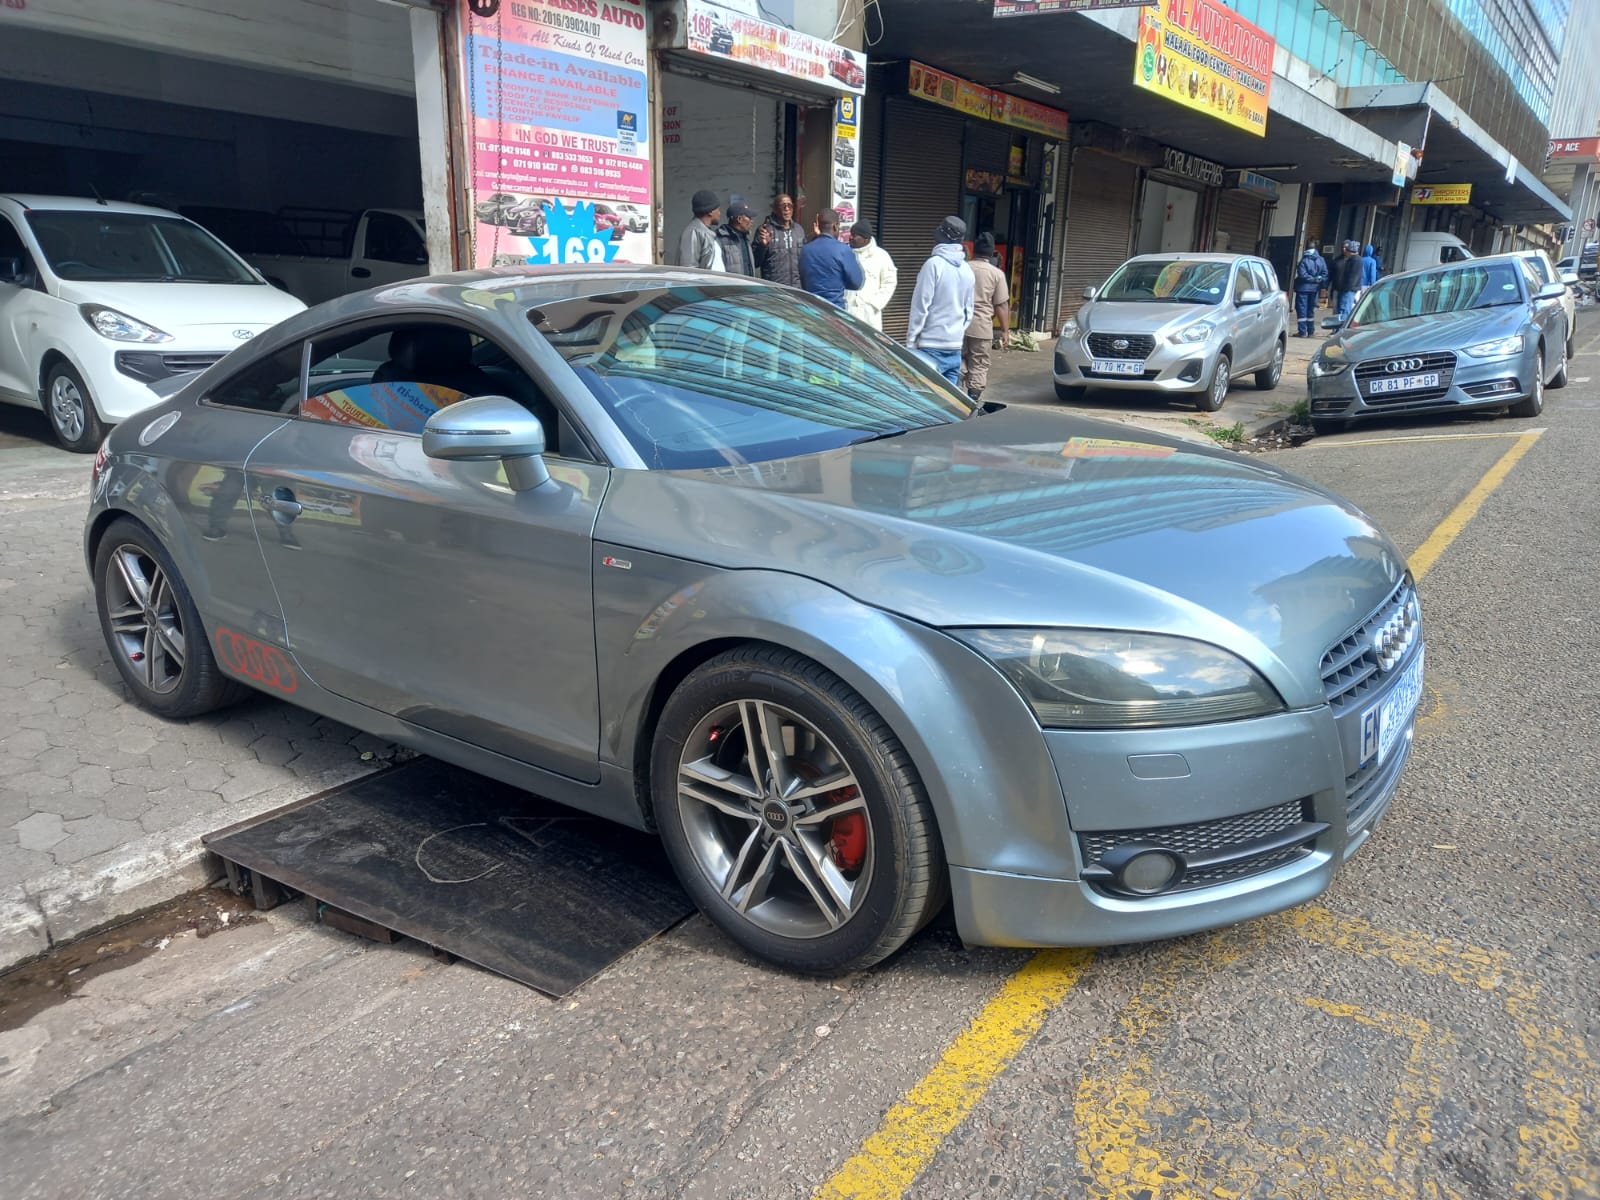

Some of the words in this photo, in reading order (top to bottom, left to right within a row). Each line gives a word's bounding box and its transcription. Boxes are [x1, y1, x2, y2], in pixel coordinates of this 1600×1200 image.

[511, 3, 527, 18] REG
[528, 7, 541, 21] NO:
[601, 3, 646, 31] AUTO
[692, 13, 711, 37] 168
[530, 30, 551, 44] All
[553, 34, 582, 52] Kinds
[585, 41, 597, 58] Of
[599, 45, 623, 61] Used
[625, 52, 646, 67] Cars
[1192, 44, 1210, 68] FOOD
[1209, 53, 1232, 79] CENTRE
[478, 44, 560, 72] Trade-in
[564, 64, 642, 89] Available
[484, 64, 546, 83] FINANCE
[549, 77, 618, 97] AVAILABLE
[534, 131, 558, 146] GOD
[561, 134, 578, 149] WE
[1371, 382, 1384, 393] CR
[1387, 380, 1399, 391] 81
[1403, 377, 1416, 389] PF
[1423, 375, 1436, 387] GP
